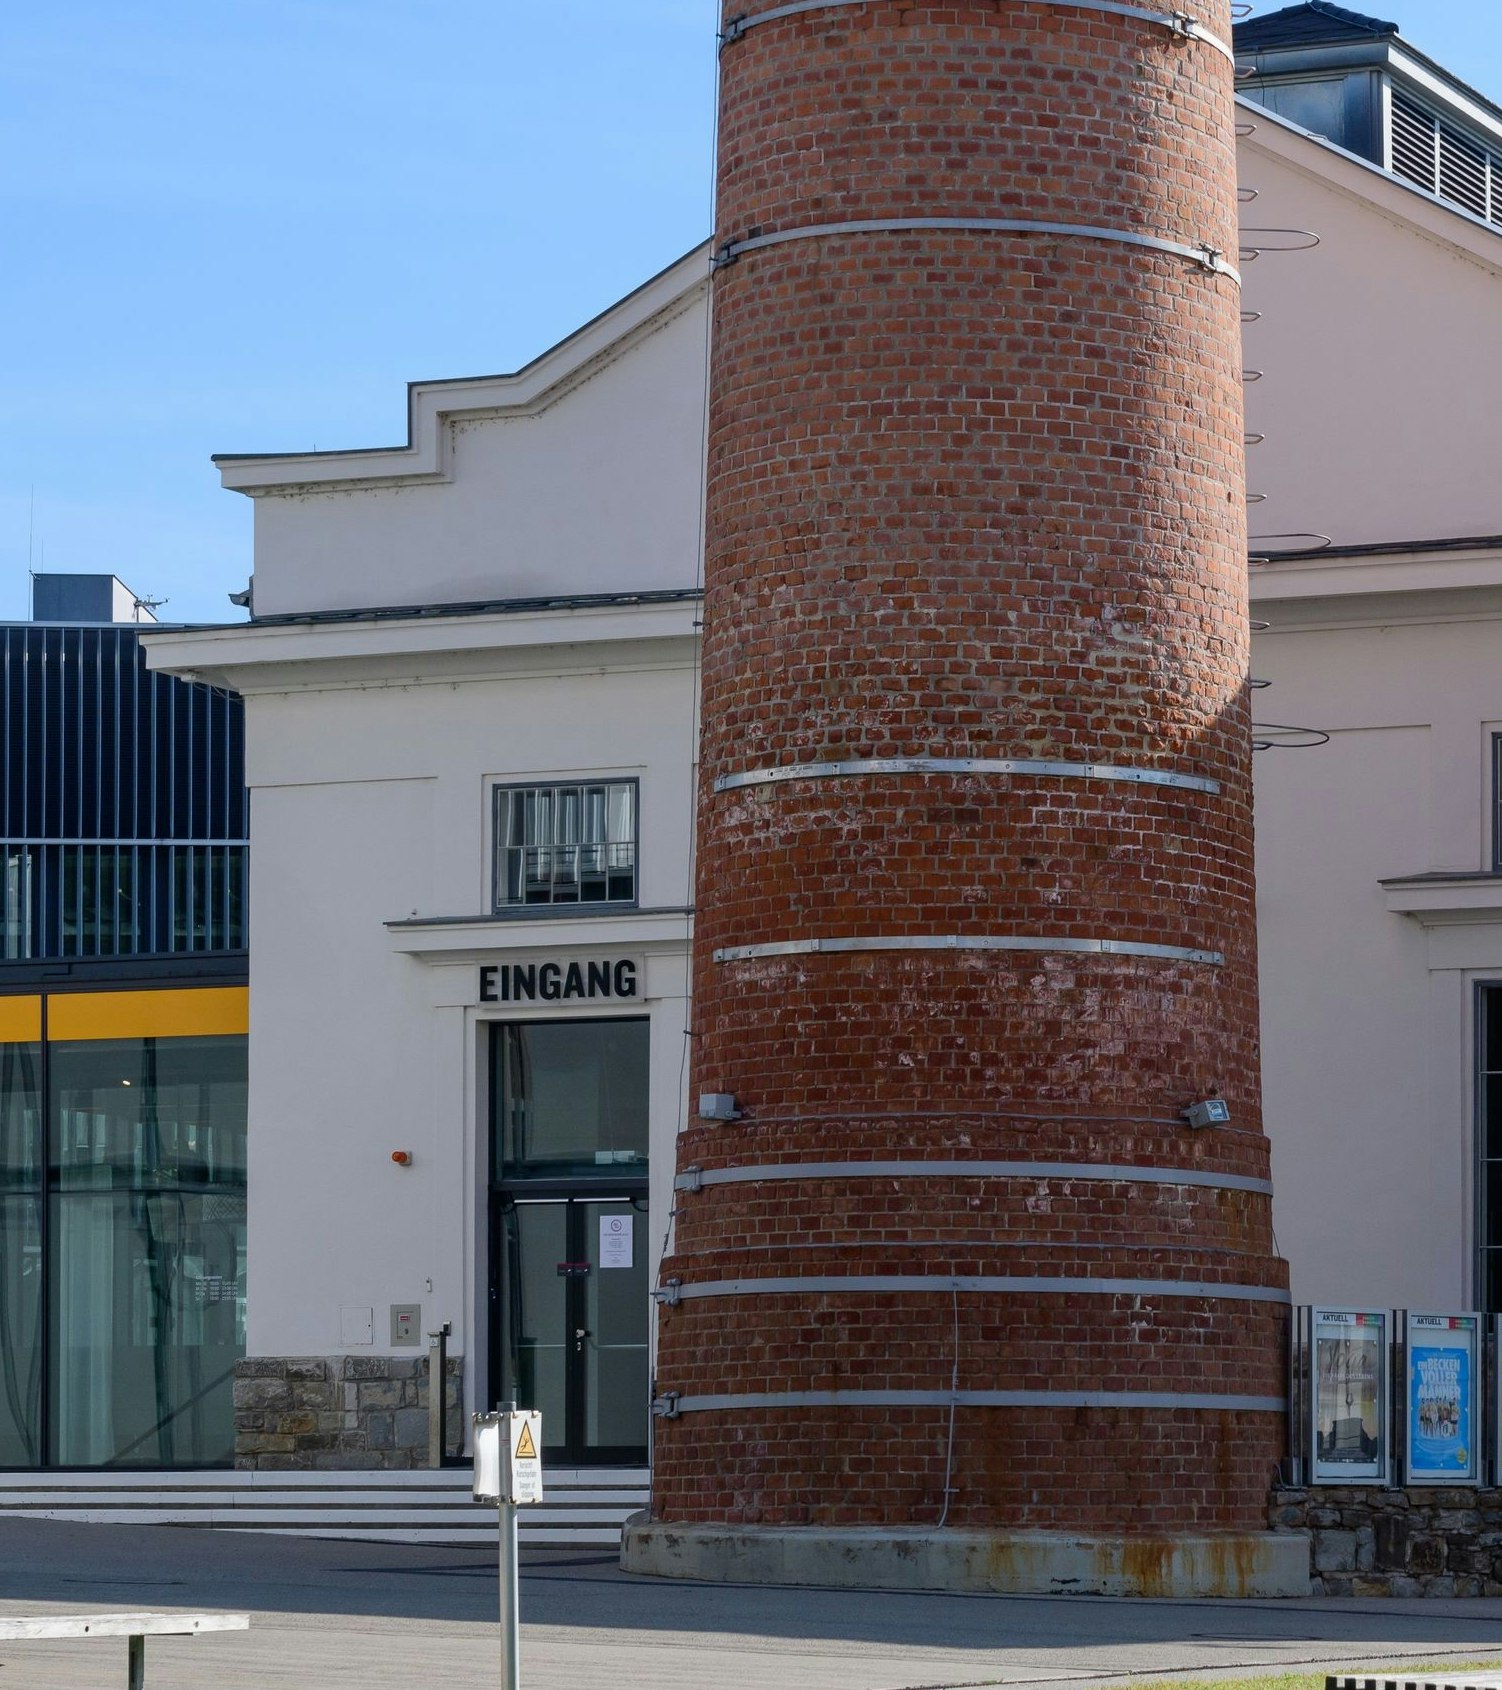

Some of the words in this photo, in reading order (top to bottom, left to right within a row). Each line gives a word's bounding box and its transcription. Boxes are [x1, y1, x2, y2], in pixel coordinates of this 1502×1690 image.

[480, 959, 636, 1002] EINGANG
[1322, 1314, 1348, 1322] AKTUELL
[1416, 1317, 1442, 1325] AKTUELL
[1428, 1358, 1460, 1371] BECKEN
[1421, 1371, 1457, 1385] VOLLER
